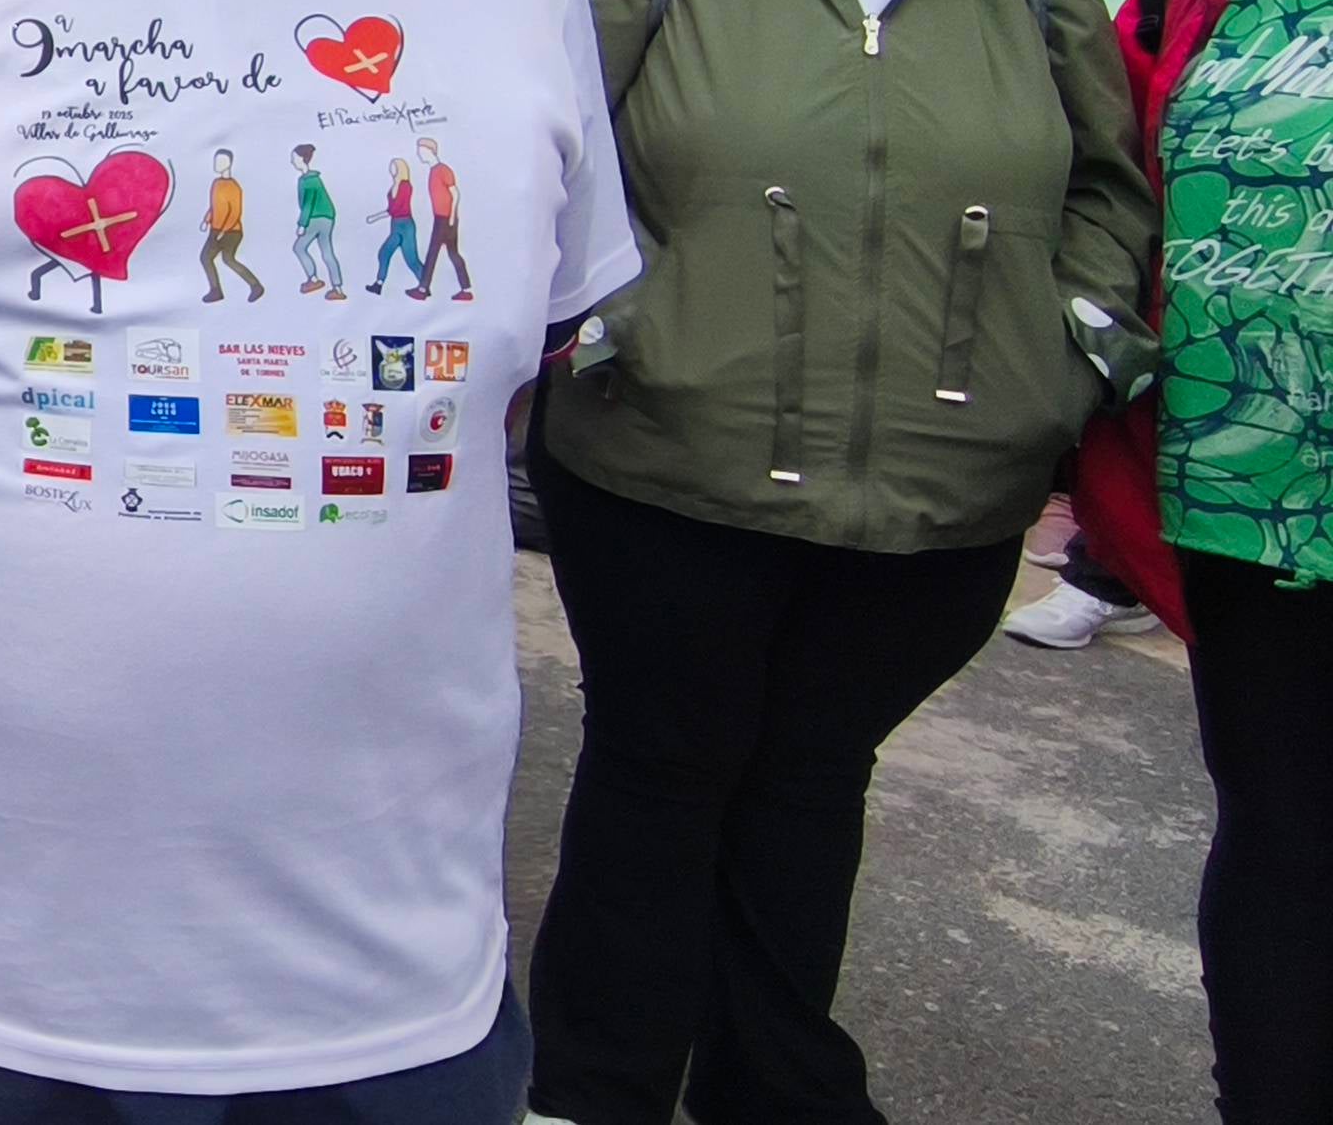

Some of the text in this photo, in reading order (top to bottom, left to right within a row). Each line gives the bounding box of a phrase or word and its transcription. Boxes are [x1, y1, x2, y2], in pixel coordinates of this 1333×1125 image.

[56, 17, 193, 62] marcha
[85, 52, 281, 106] a favor de
[1190, 125, 1294, 163] Let's
[1221, 190, 1296, 227] this
[1161, 238, 1333, 296] TOGETH
[244, 343, 264, 354] LAS
[268, 345, 305, 356] NIEVES
[22, 387, 95, 409] dpical
[226, 393, 294, 409] ELEXMAR
[251, 504, 299, 519] insadof
